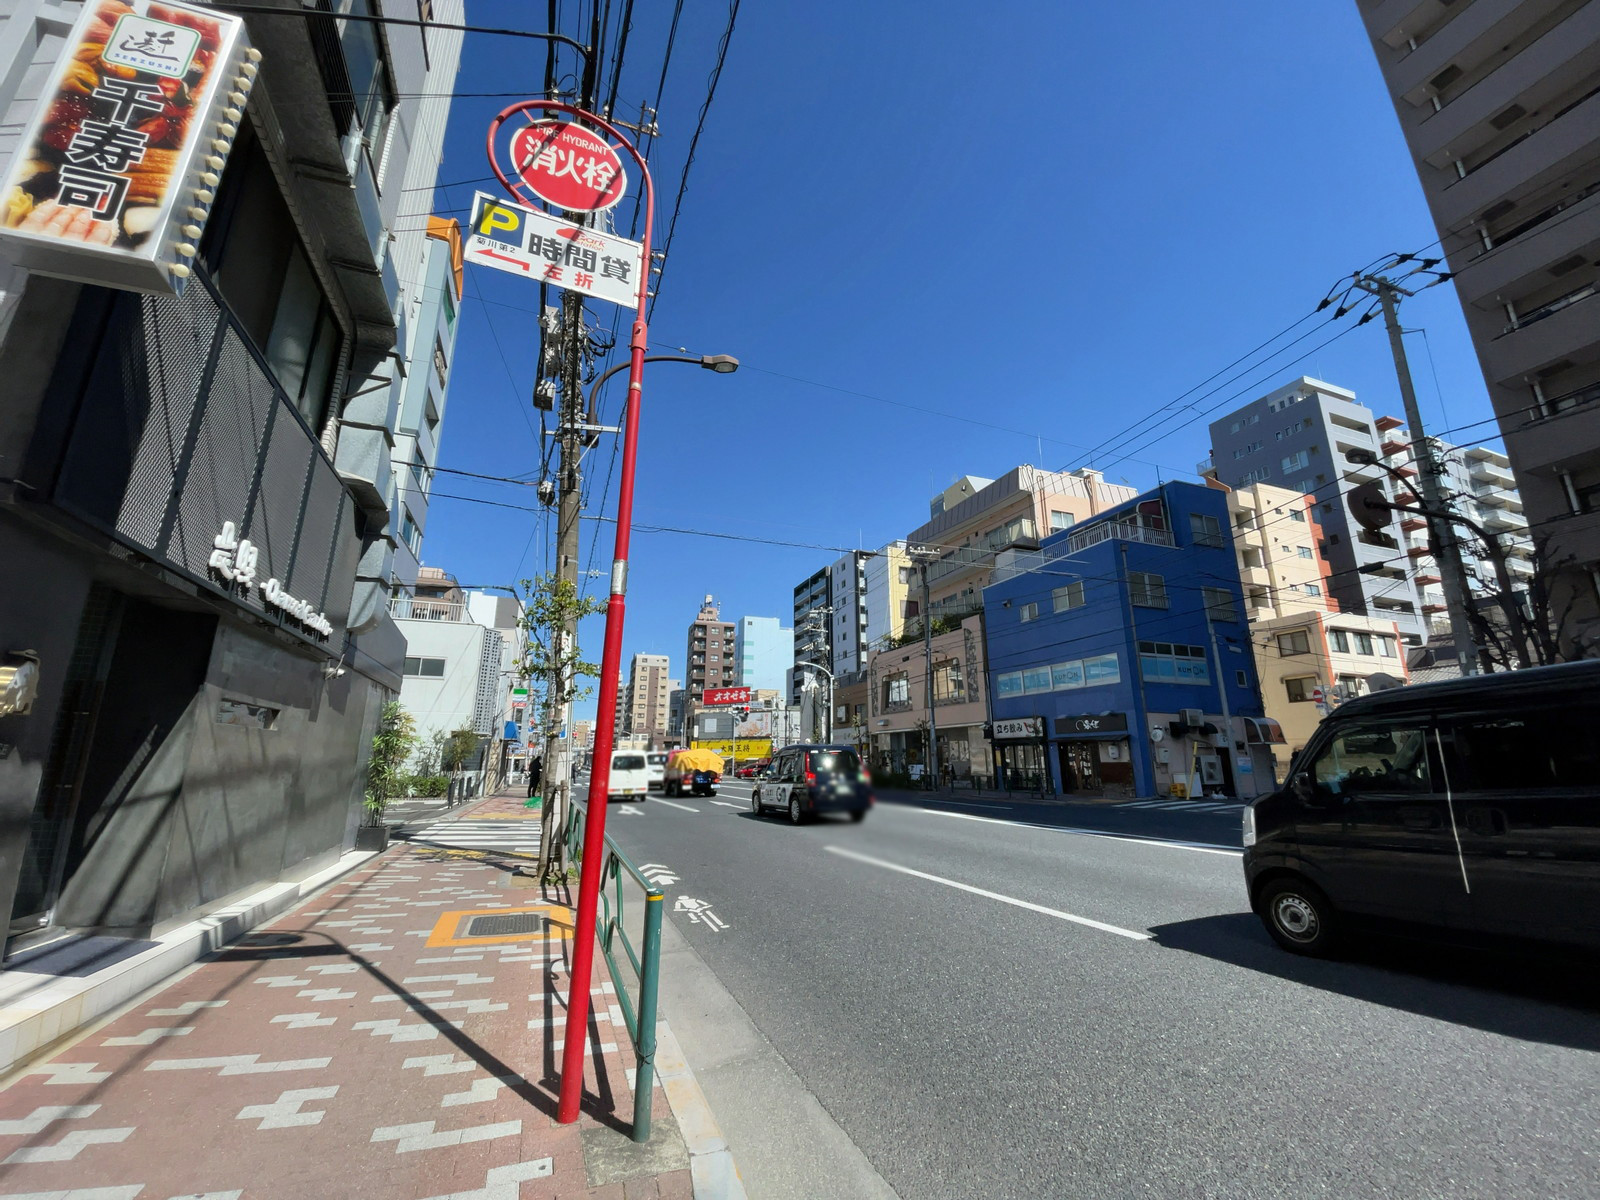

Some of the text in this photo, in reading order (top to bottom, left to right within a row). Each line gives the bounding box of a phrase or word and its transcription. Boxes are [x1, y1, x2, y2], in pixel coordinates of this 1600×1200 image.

[114, 53, 178, 72] SENZUSHI
[56, 76, 164, 223] 千寿司
[536, 124, 609, 156] FIRE HYDRANT
[522, 135, 616, 195] 消火栓
[479, 202, 519, 236] P
[476, 236, 516, 254] 菊川第2
[528, 232, 632, 285] 時間貸
[543, 263, 594, 290] 左折
[1054, 672, 1079, 681] KUMON
[1177, 665, 1205, 676] KUMON
[713, 690, 747, 702] オオゼキ
[996, 722, 1023, 734] 立ち飲み
